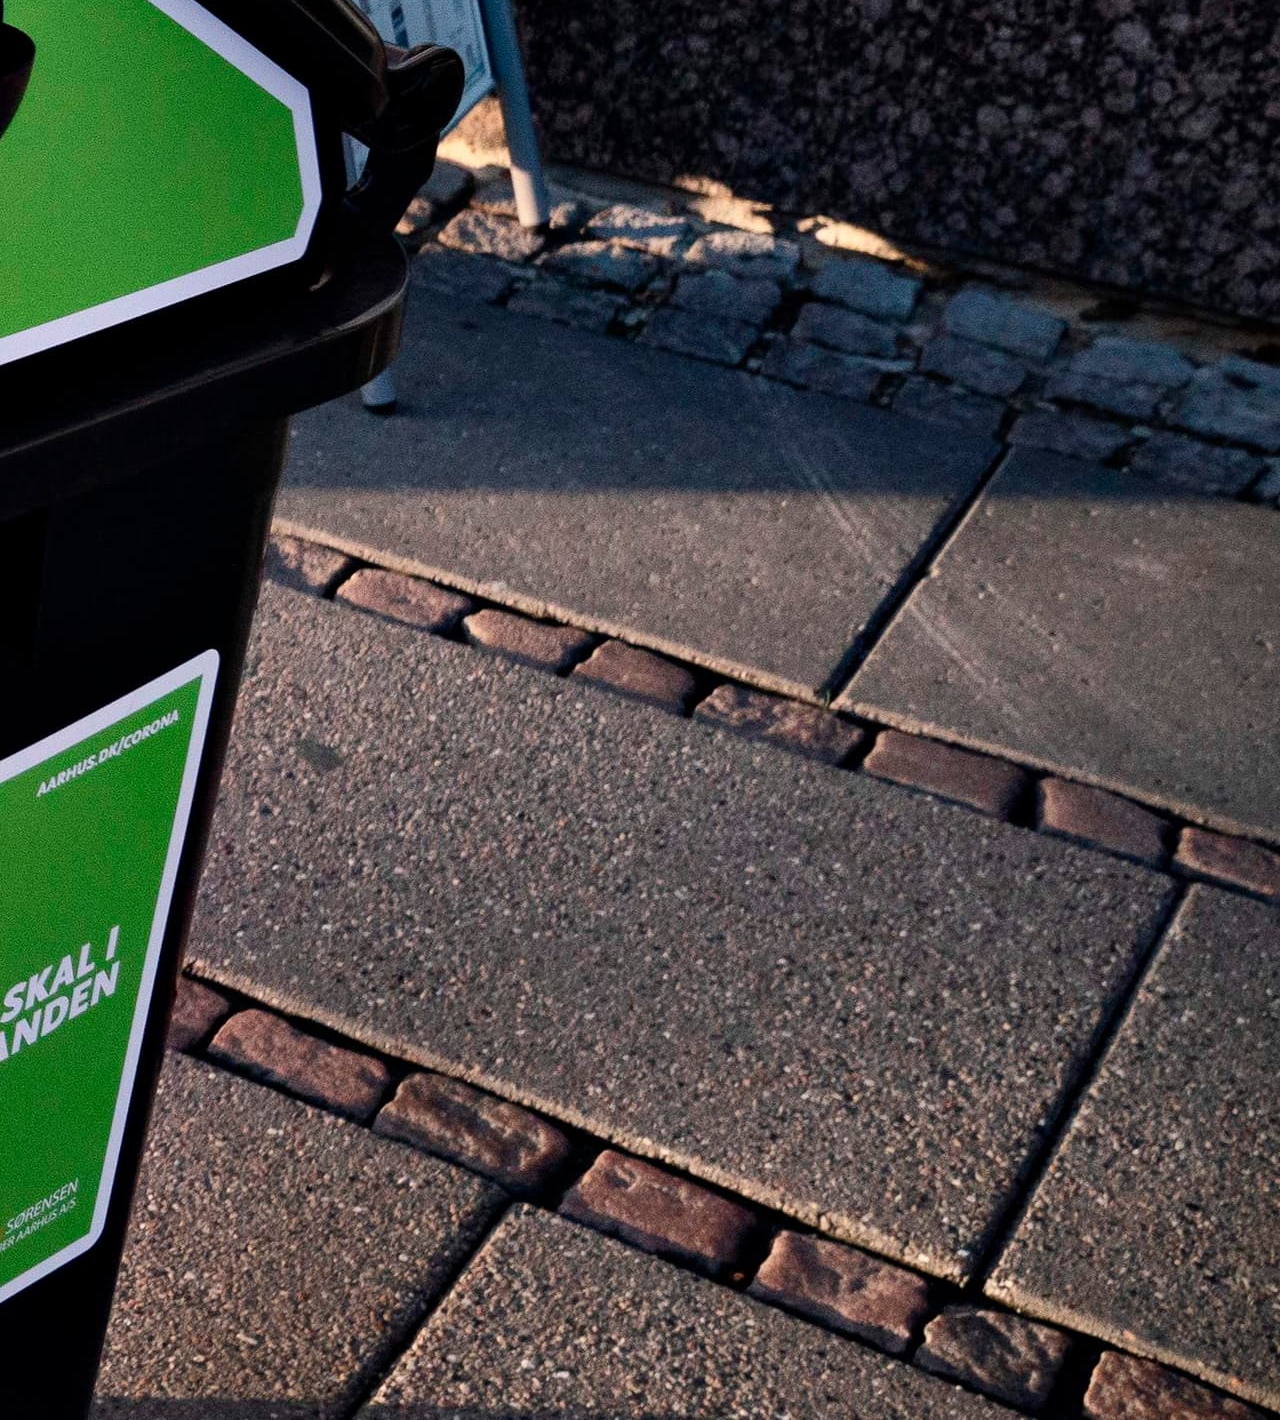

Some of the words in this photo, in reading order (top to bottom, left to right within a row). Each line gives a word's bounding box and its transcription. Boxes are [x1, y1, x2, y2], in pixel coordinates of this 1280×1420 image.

[36, 709, 180, 798] AARHUS.DK/CORONA
[0, 941, 95, 1023] SKAL
[105, 924, 120, 960] I
